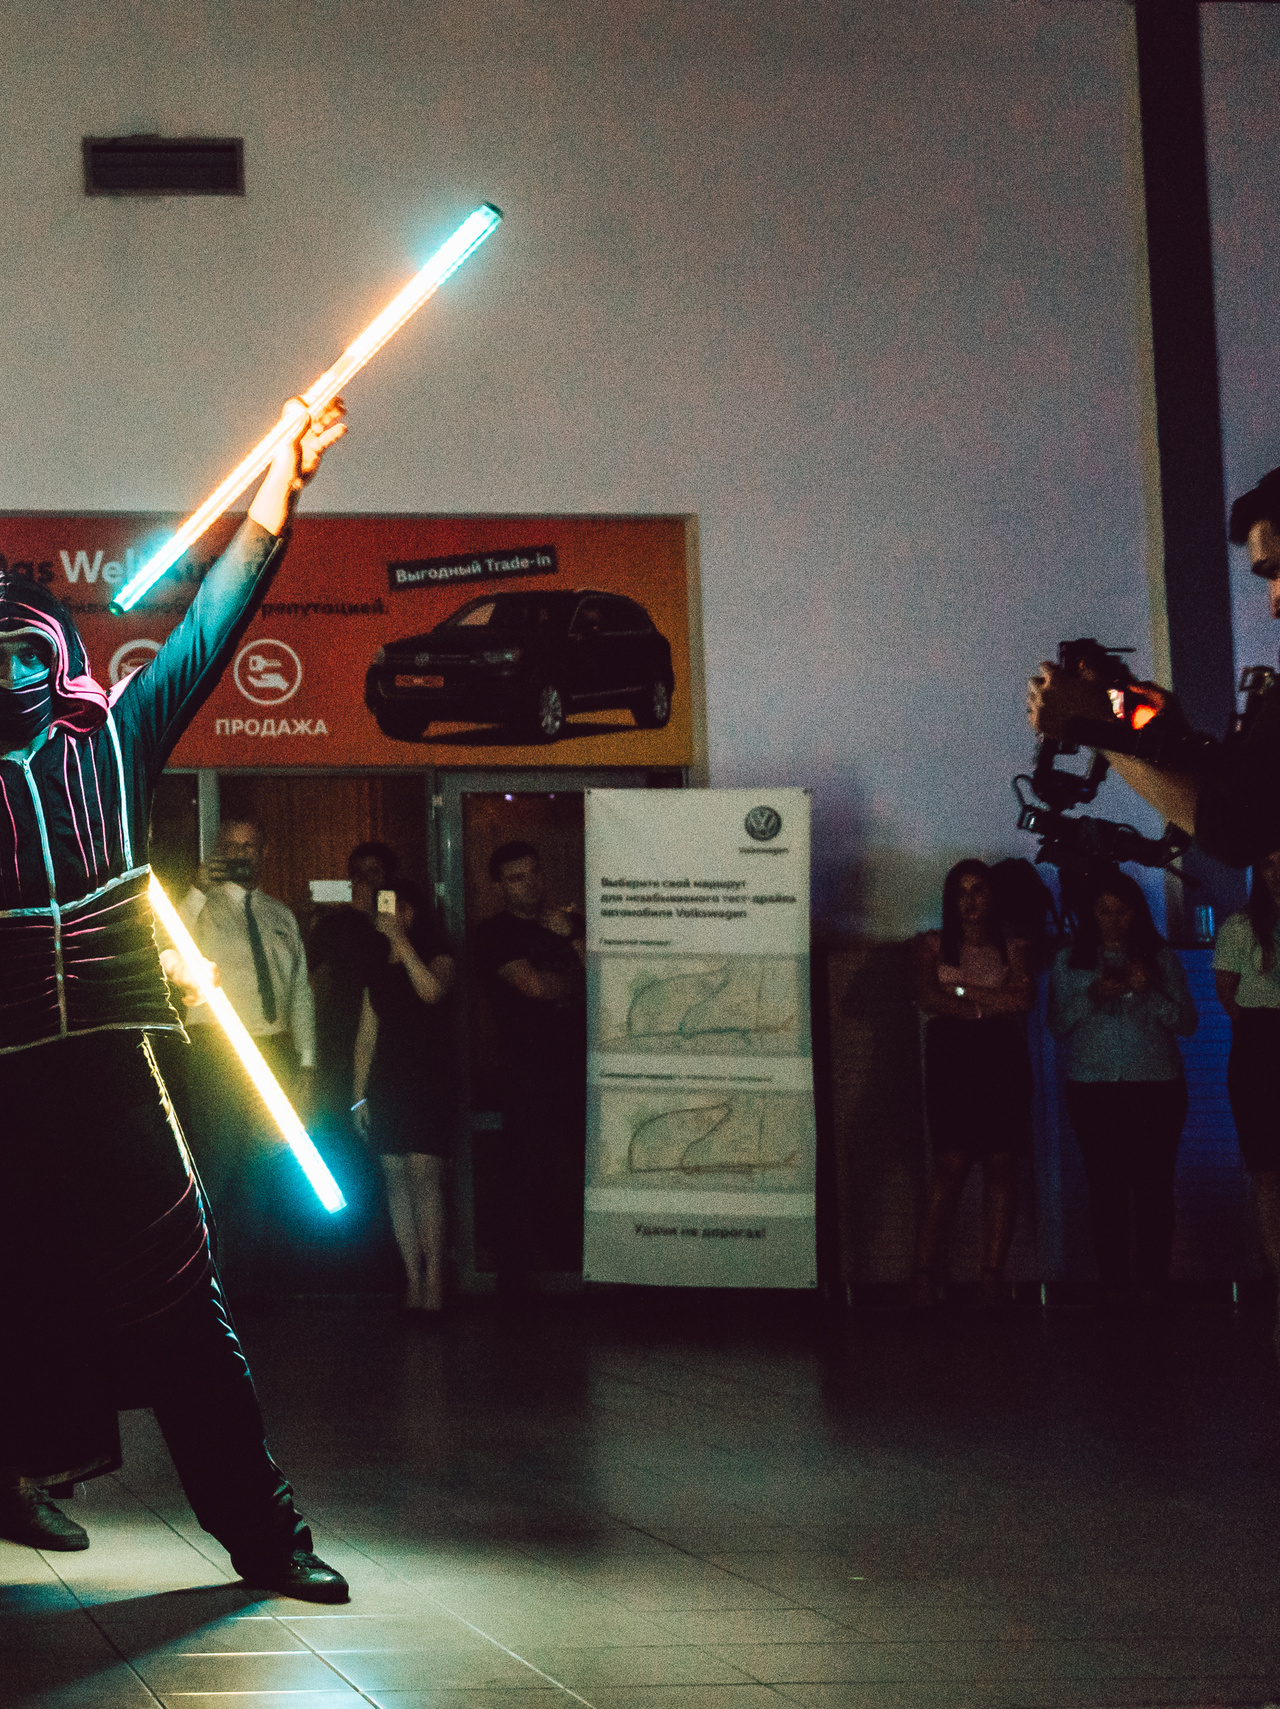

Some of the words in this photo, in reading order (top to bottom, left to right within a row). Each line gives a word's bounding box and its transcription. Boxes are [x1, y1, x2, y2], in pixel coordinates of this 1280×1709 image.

[394, 560, 483, 584] Выгодный
[485, 553, 552, 573] Trade-in
[214, 717, 329, 738] ПРОДАЖА
[675, 907, 748, 920] Volkswagen
